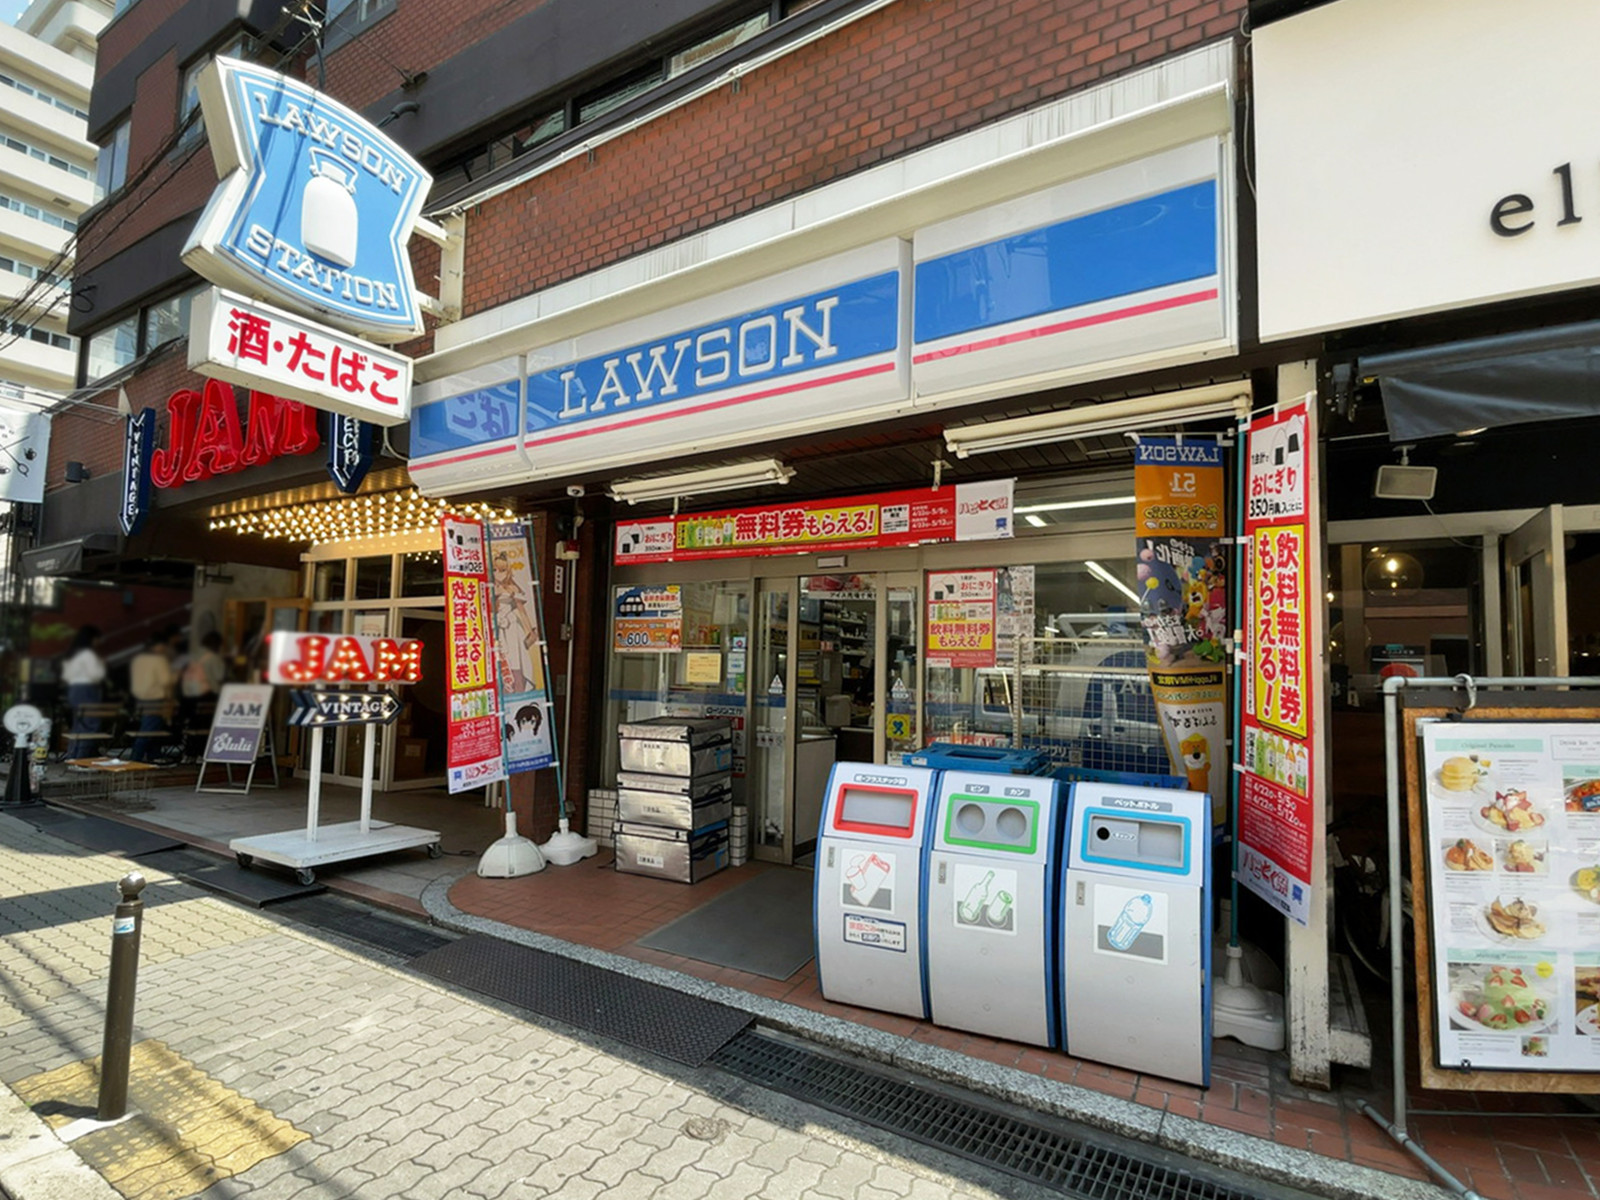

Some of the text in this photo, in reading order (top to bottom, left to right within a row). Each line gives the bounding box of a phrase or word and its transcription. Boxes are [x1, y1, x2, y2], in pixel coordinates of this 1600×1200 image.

[254, 92, 405, 195] LAWSON
[247, 223, 397, 310] STATION
[228, 307, 399, 405] 酒・たばこ
[558, 296, 839, 419] LAWSON
[127, 431, 141, 516] VINTAGE
[151, 378, 320, 489] JAM
[735, 509, 875, 541] 無料券もらえる!
[1252, 466, 1297, 497] おにぎり
[278, 635, 424, 682] JAM
[1258, 533, 1277, 718] もらえる!
[1276, 532, 1301, 726] 飲料無料券
[223, 703, 263, 716] JAM
[321, 701, 390, 714] VINTAGE
